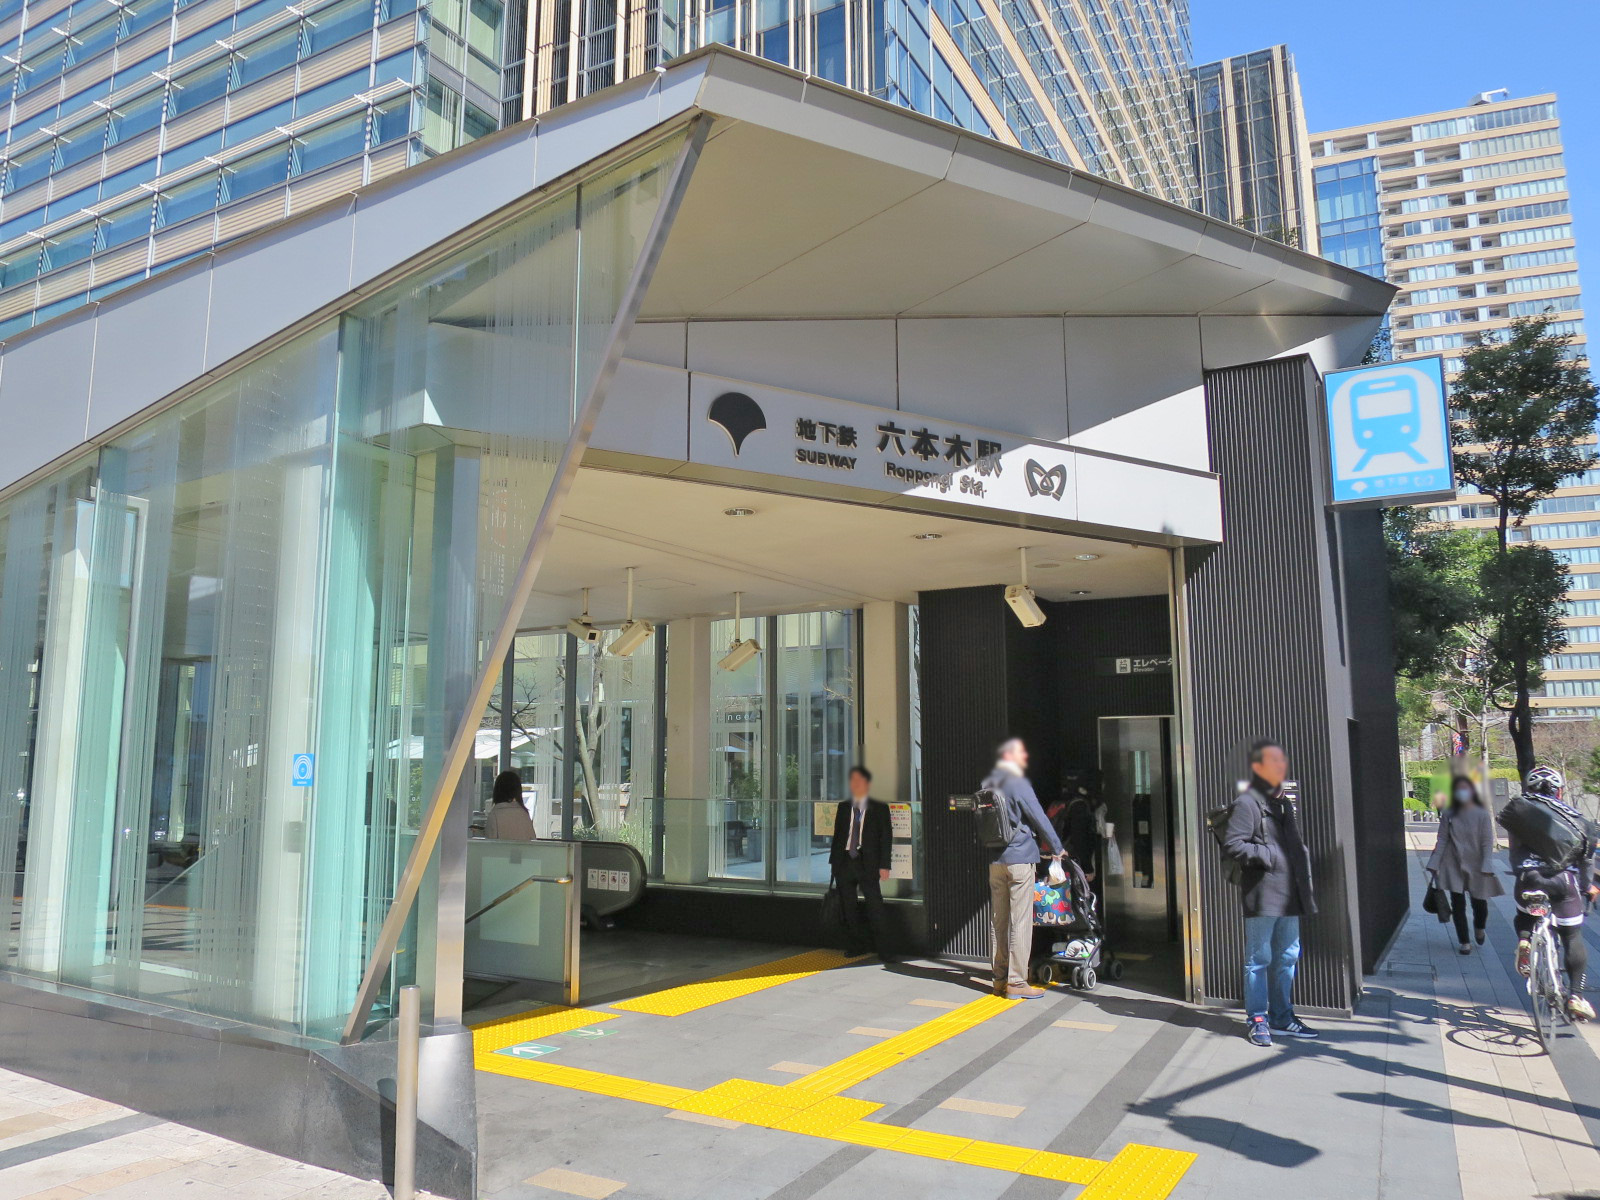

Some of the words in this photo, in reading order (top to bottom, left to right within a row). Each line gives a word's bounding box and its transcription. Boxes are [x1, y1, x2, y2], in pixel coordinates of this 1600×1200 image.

[796, 418, 857, 448] 地下鉄
[875, 421, 1003, 478] 六本木駅
[796, 449, 857, 470] SUBWAY
[884, 462, 953, 493] Roppongi
[960, 475, 988, 499] Sta.
